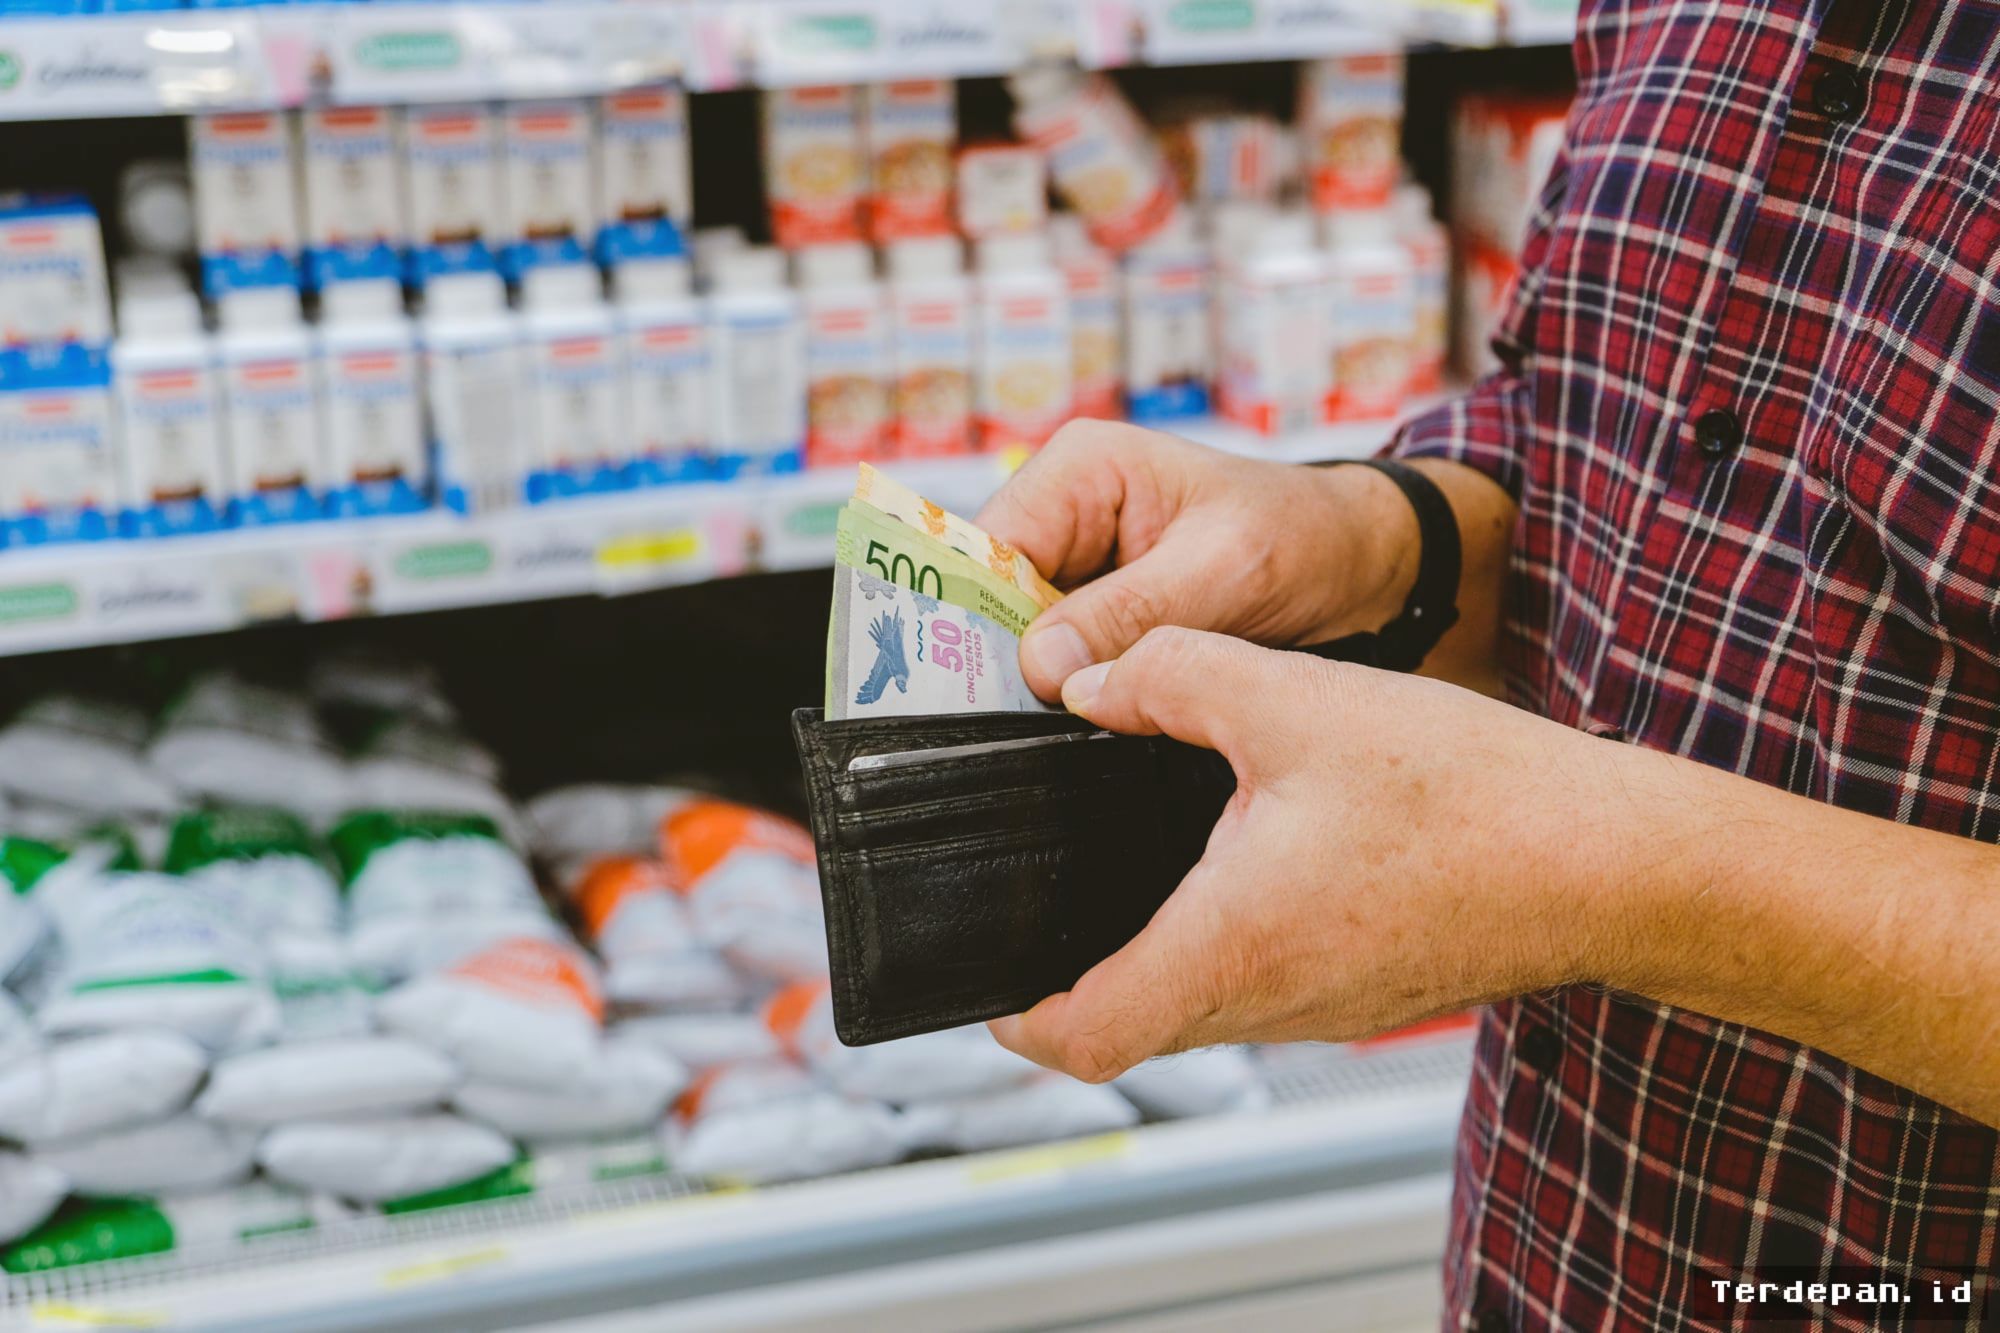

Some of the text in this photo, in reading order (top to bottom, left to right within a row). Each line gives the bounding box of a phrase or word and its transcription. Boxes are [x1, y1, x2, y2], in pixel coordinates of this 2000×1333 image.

[866, 539, 942, 600] 500
[931, 619, 963, 672] 50
[965, 629, 976, 704] CINCUENTA
[974, 633, 984, 677] PESOS
